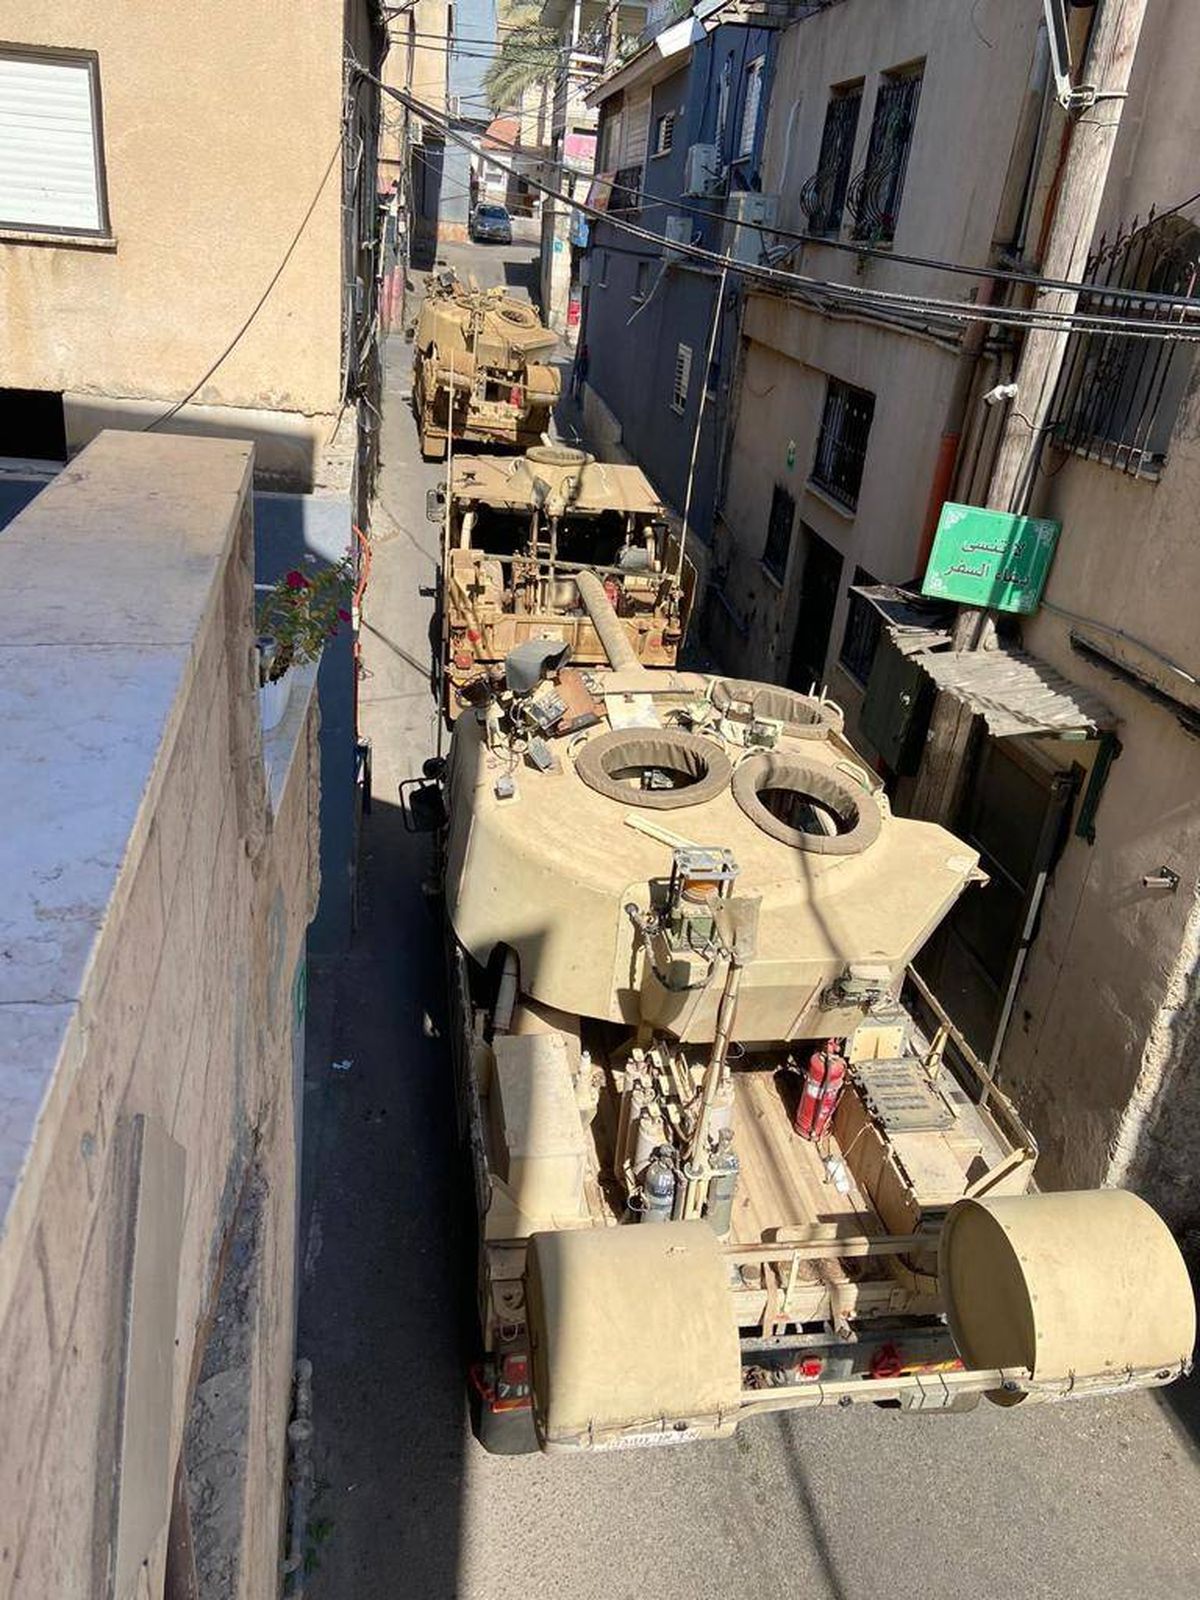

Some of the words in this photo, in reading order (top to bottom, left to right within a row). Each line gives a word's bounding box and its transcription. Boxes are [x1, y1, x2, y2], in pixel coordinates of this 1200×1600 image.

[961, 538, 1011, 555] تنسى
[1013, 541, 1026, 557] لا
[944, 559, 990, 578] السفر
